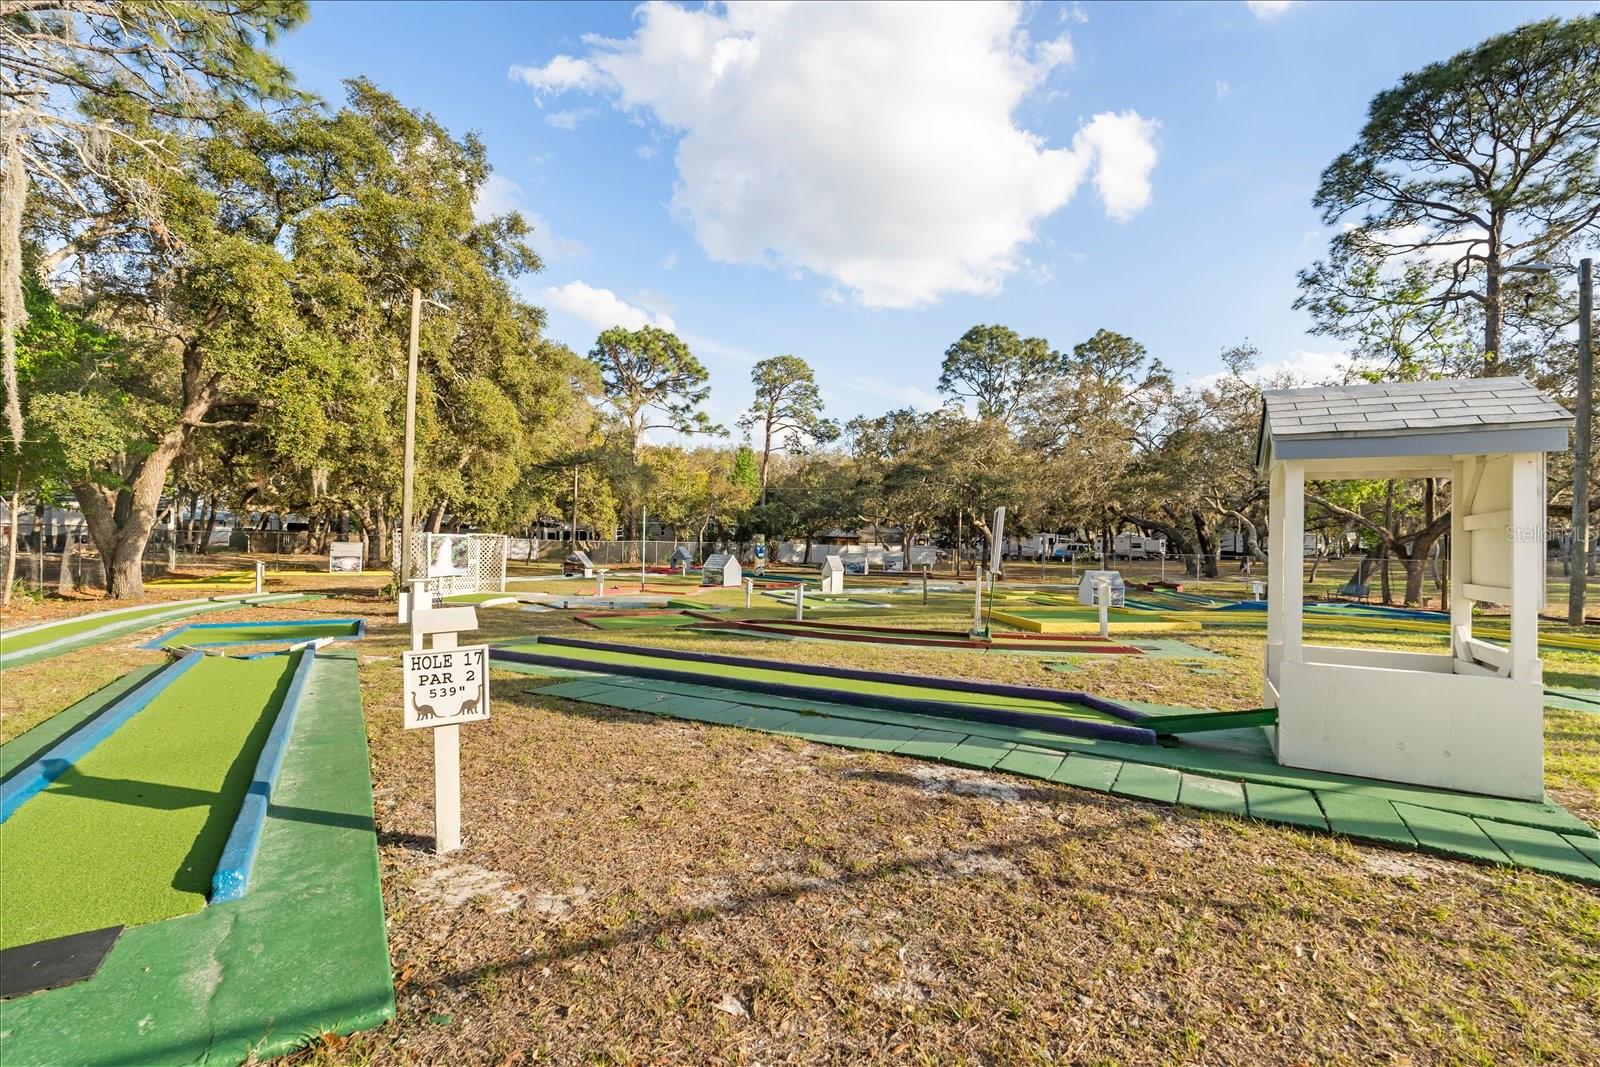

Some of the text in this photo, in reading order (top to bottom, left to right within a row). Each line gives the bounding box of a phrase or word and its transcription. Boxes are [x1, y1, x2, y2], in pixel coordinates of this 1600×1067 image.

[411, 651, 482, 671] HOLE 17
[418, 670, 475, 686] PAR 2
[429, 686, 465, 698] 539"
